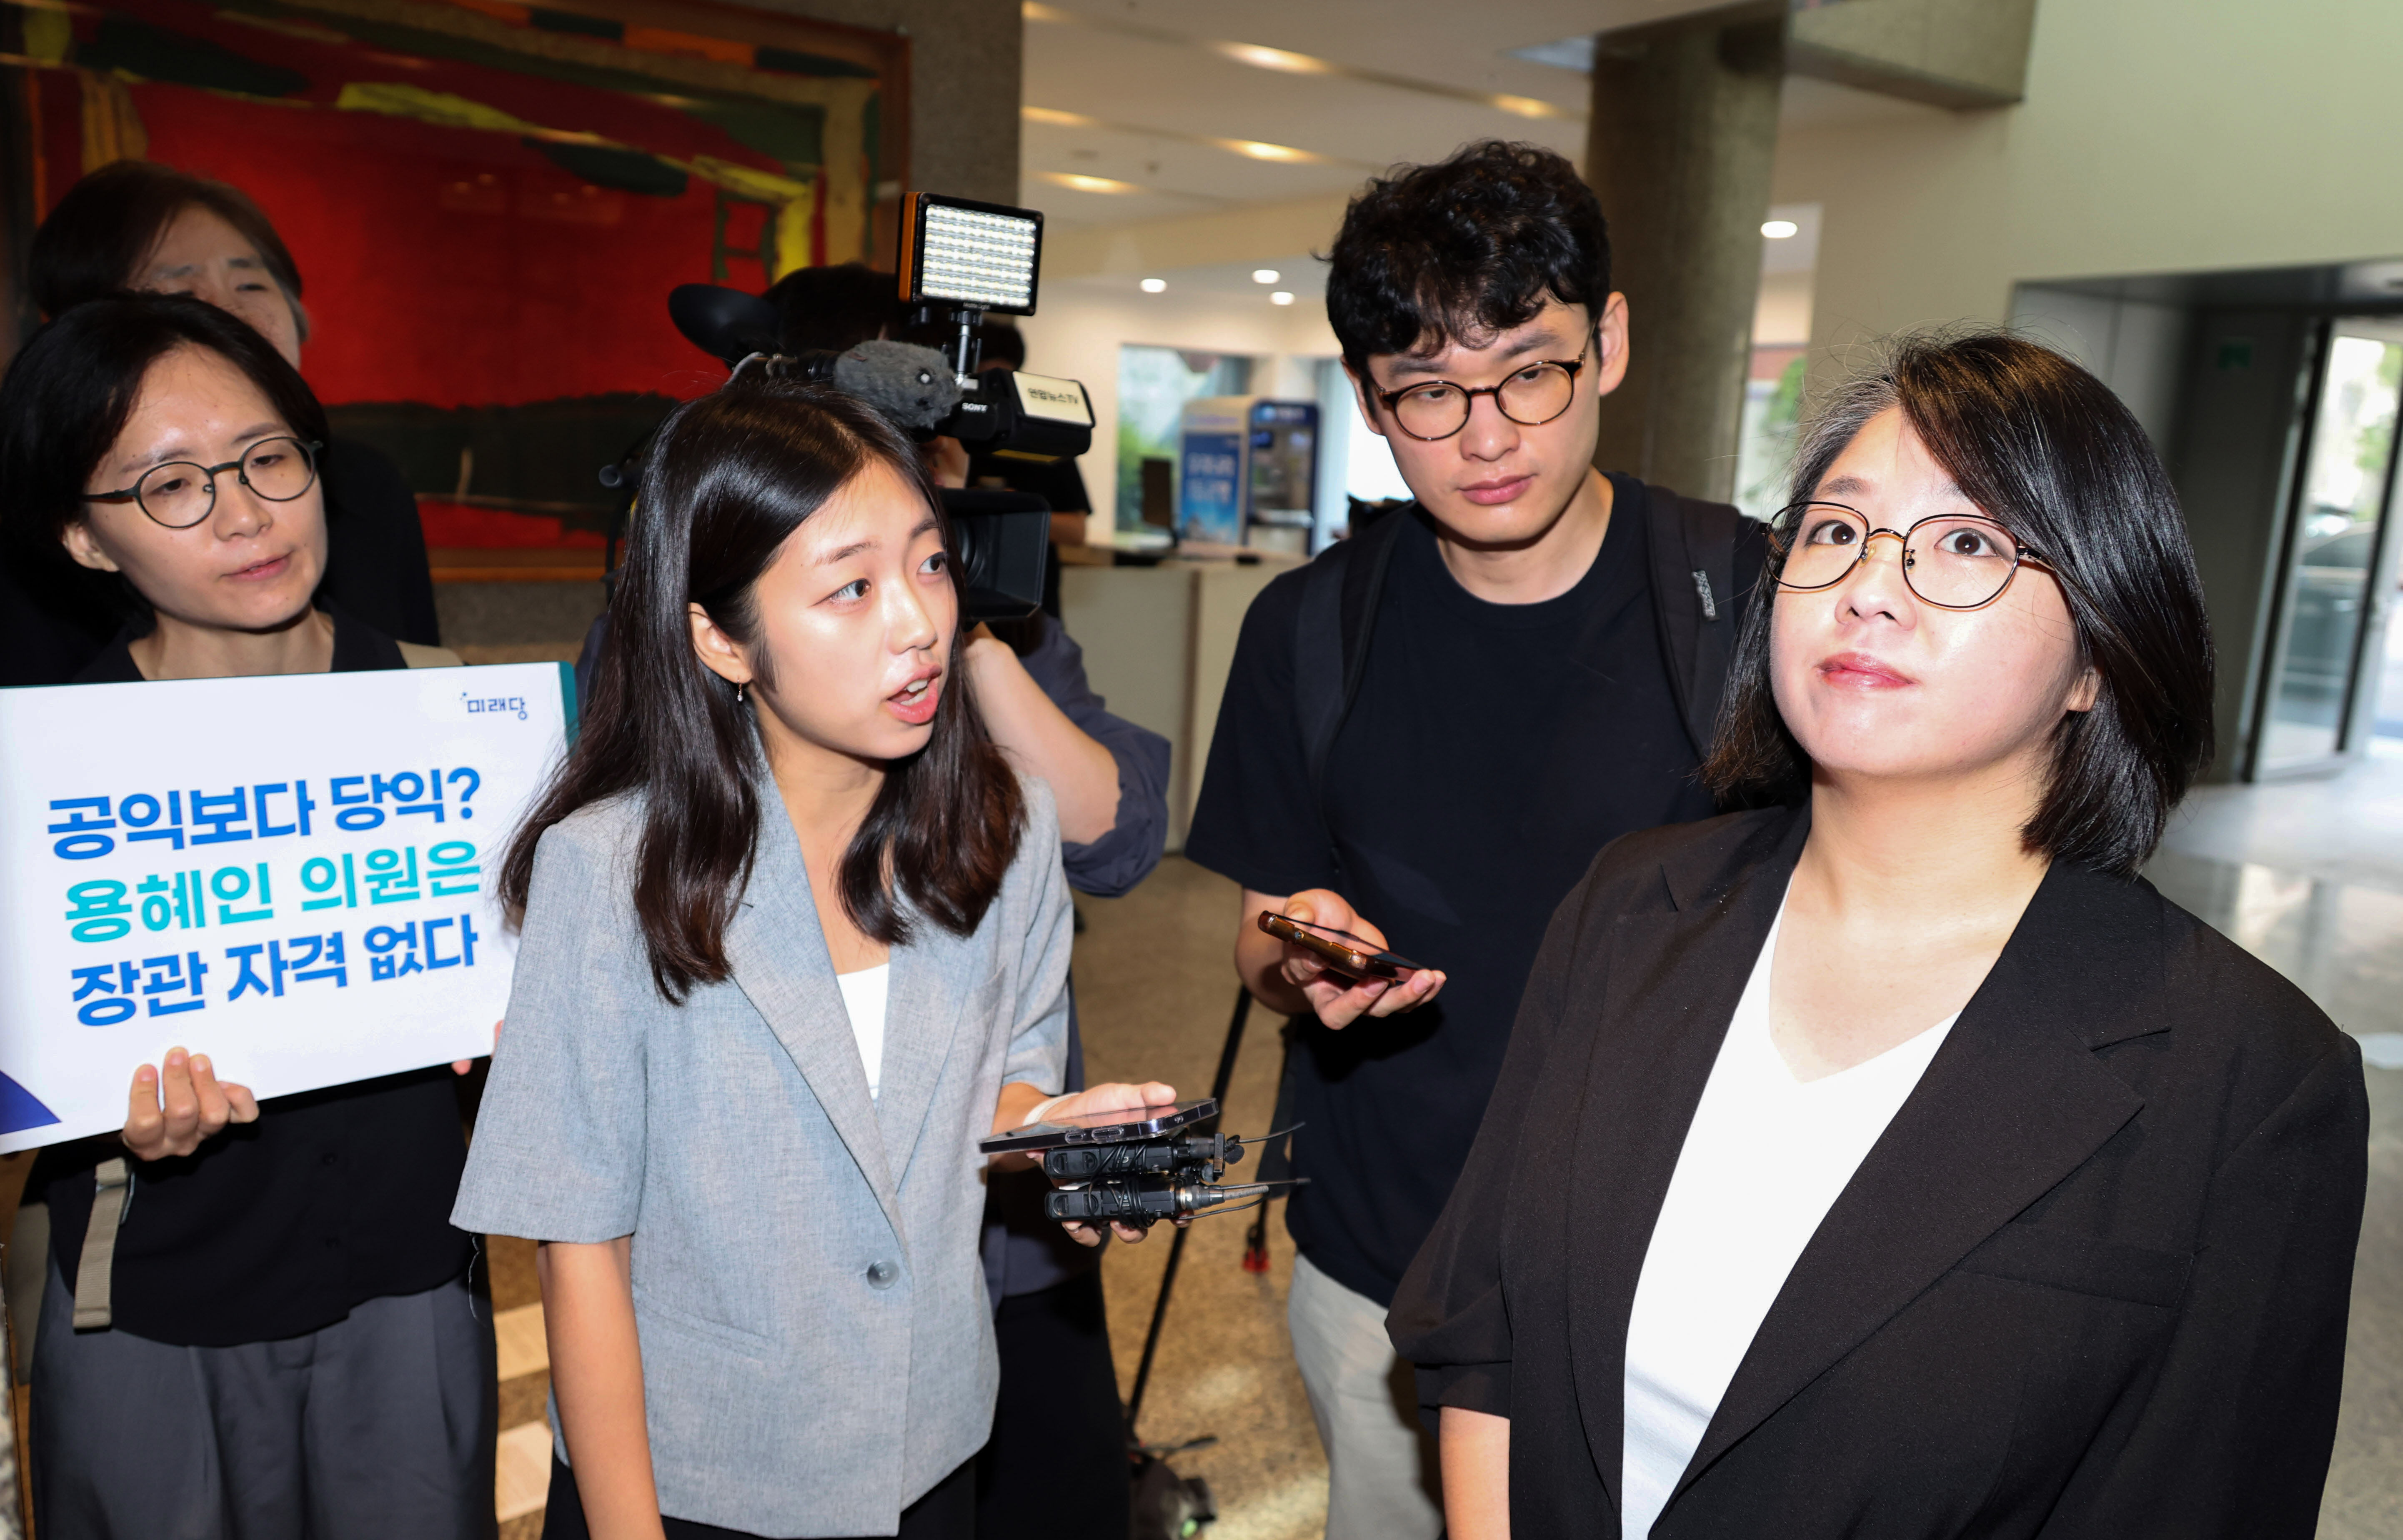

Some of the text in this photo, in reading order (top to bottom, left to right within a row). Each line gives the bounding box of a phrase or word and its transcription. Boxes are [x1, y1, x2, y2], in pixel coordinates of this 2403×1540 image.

[962, 402, 988, 413] SONY
[1028, 388, 1078, 404] 연합뉴스TV
[467, 697, 528, 720] 미래당
[47, 766, 481, 860] 공익보다 당익?
[65, 840, 482, 943] 용혜인 의원은
[70, 913, 478, 1027] 장관 자격 없다
